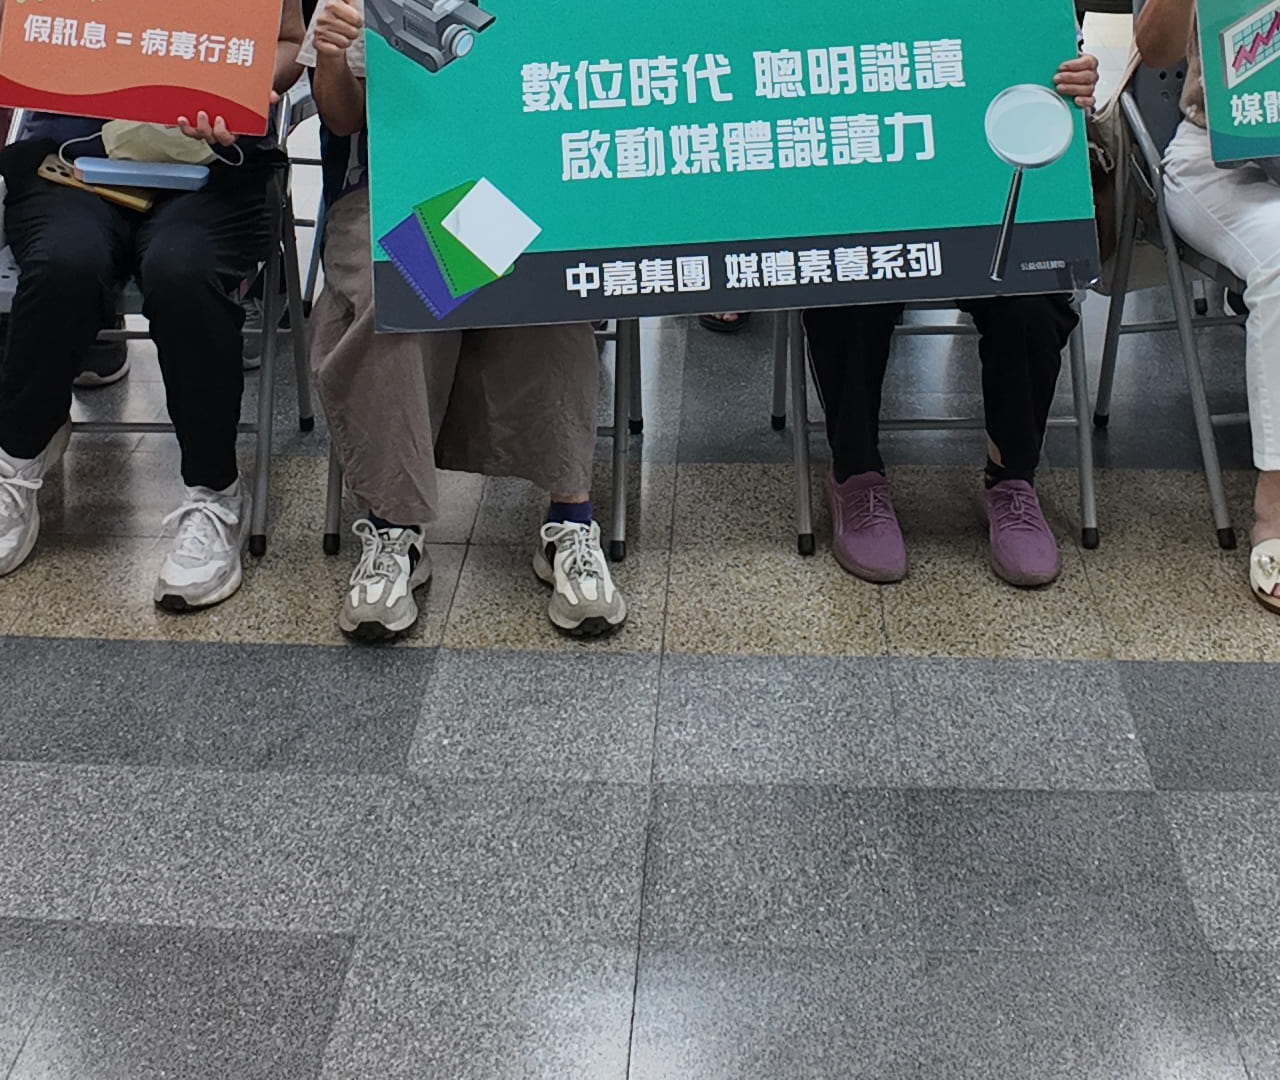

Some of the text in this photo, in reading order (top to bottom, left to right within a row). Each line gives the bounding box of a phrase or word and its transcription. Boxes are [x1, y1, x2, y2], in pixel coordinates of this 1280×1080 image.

[23, 13, 108, 51] 假訊息
[141, 27, 256, 68] 病毒行銷
[520, 37, 967, 114] 數位時代 聰明識讀
[560, 111, 936, 182] 啟動媒體識讀力
[565, 241, 944, 300] 中嘉集團 媒體素養系列
